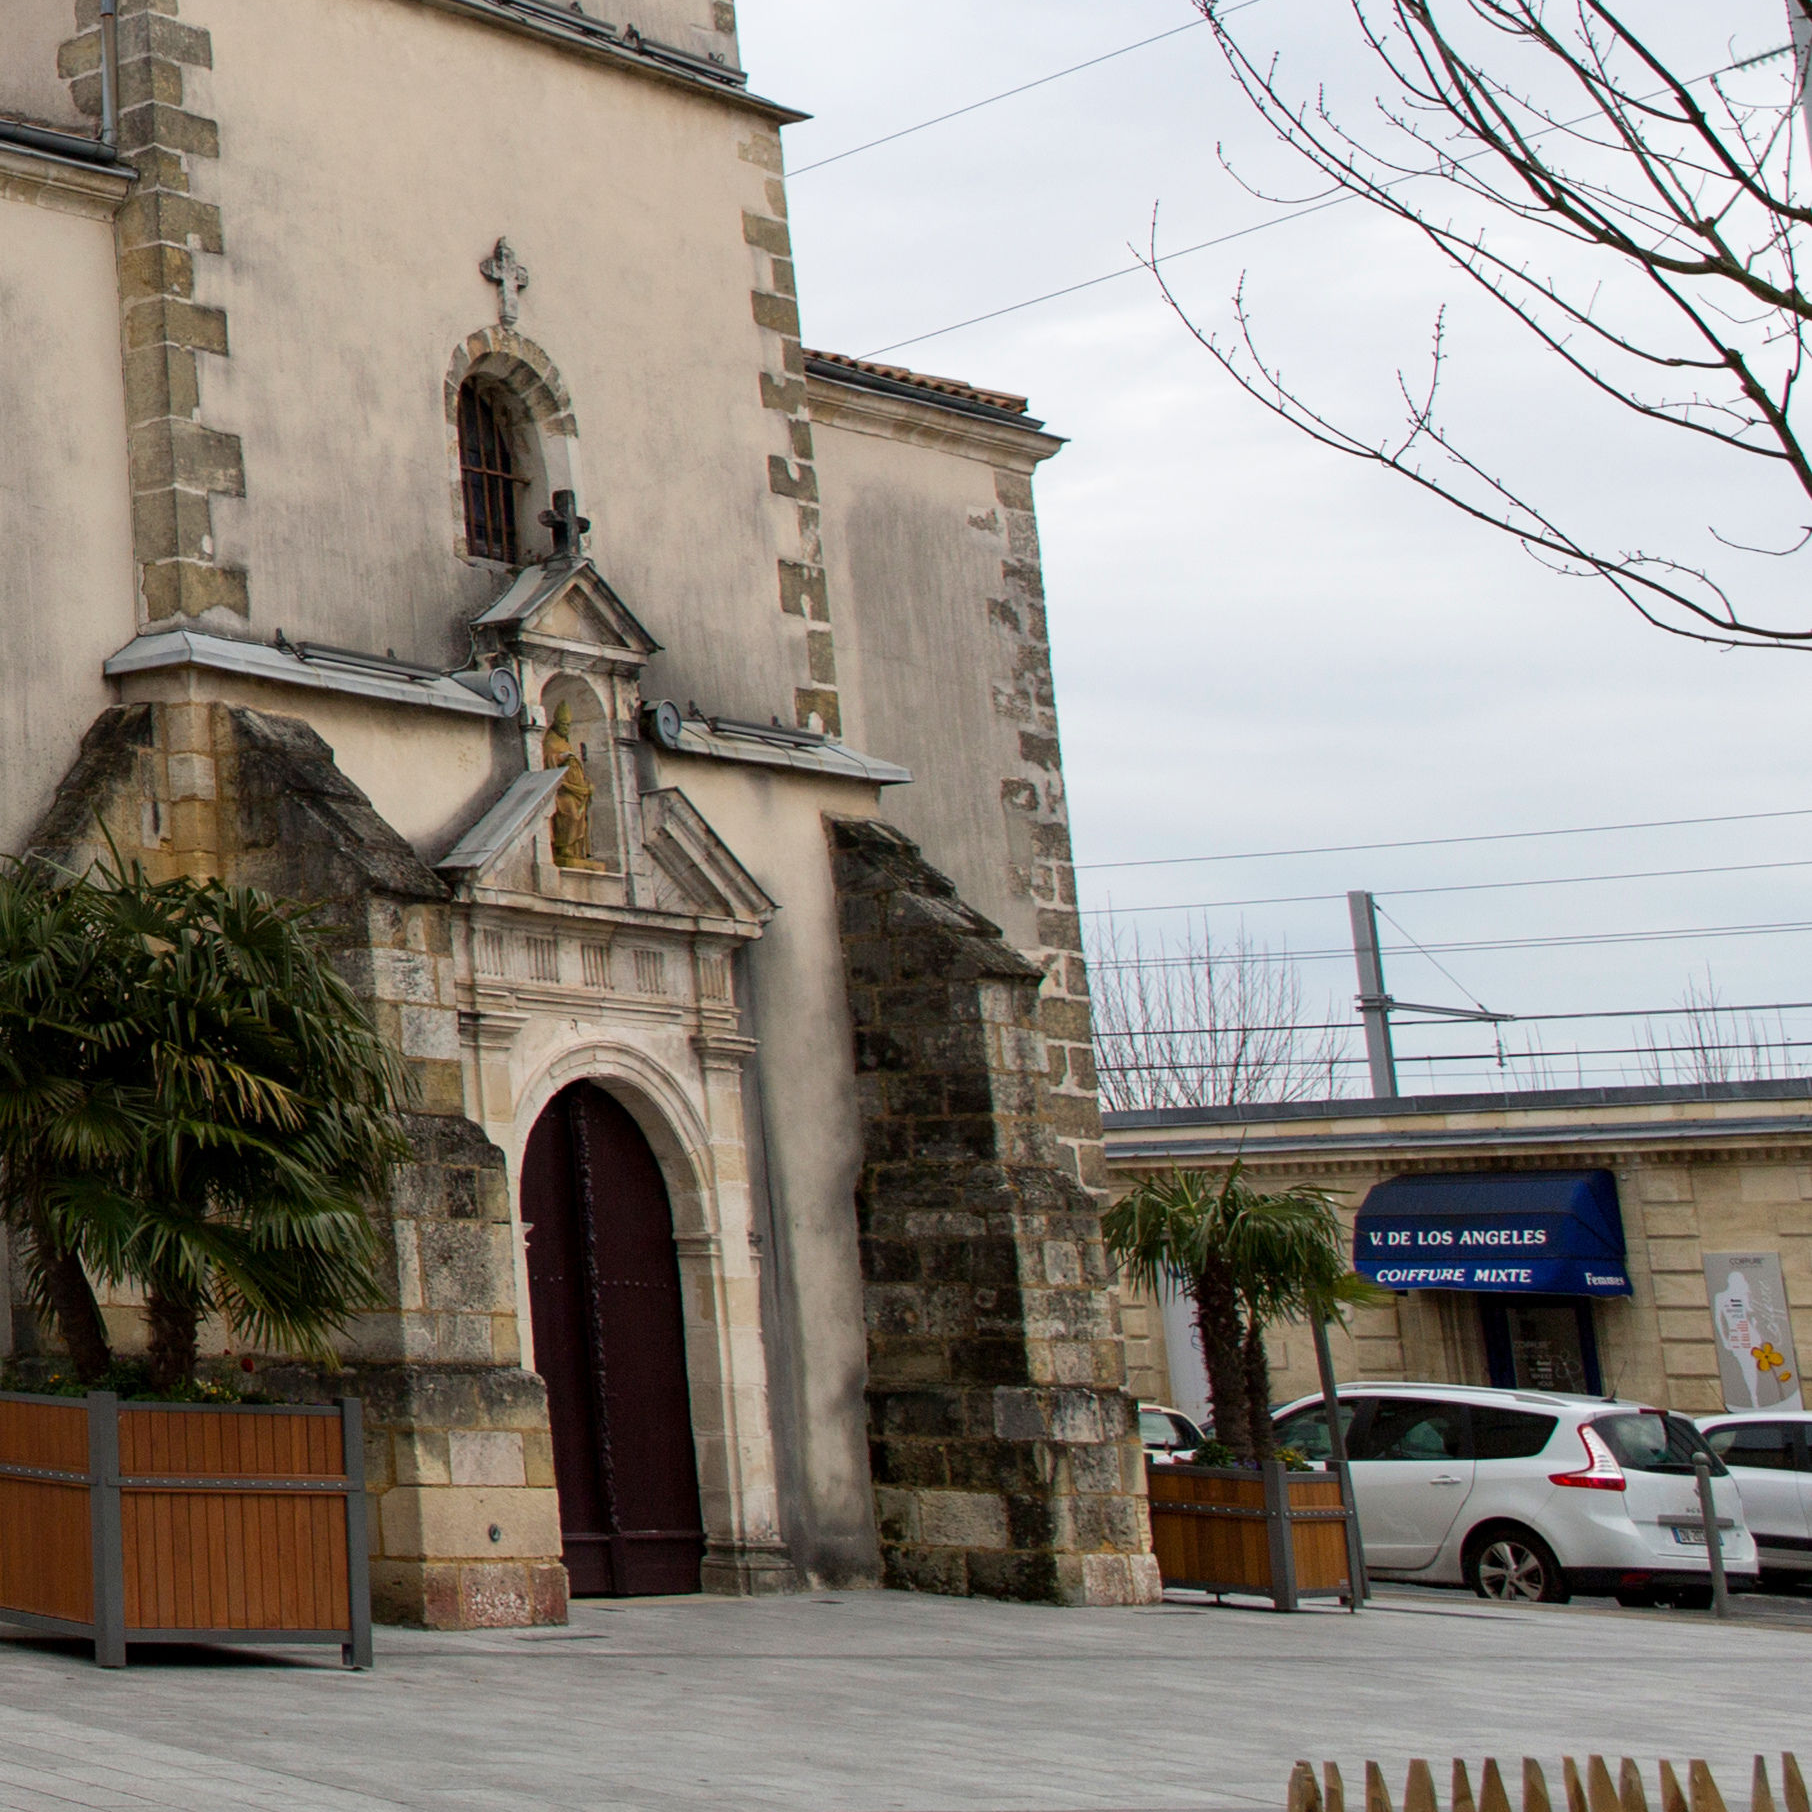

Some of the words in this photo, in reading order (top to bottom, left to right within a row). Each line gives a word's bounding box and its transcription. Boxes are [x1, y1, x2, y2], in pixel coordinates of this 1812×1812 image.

[1369, 1232, 1383, 1246] V.
[1387, 1231, 1411, 1245] DE
[1417, 1231, 1453, 1245] LOS
[1459, 1229, 1546, 1245] ANGELES
[1376, 1268, 1465, 1283] COIFFURE
[1474, 1268, 1532, 1283] MIXTE
